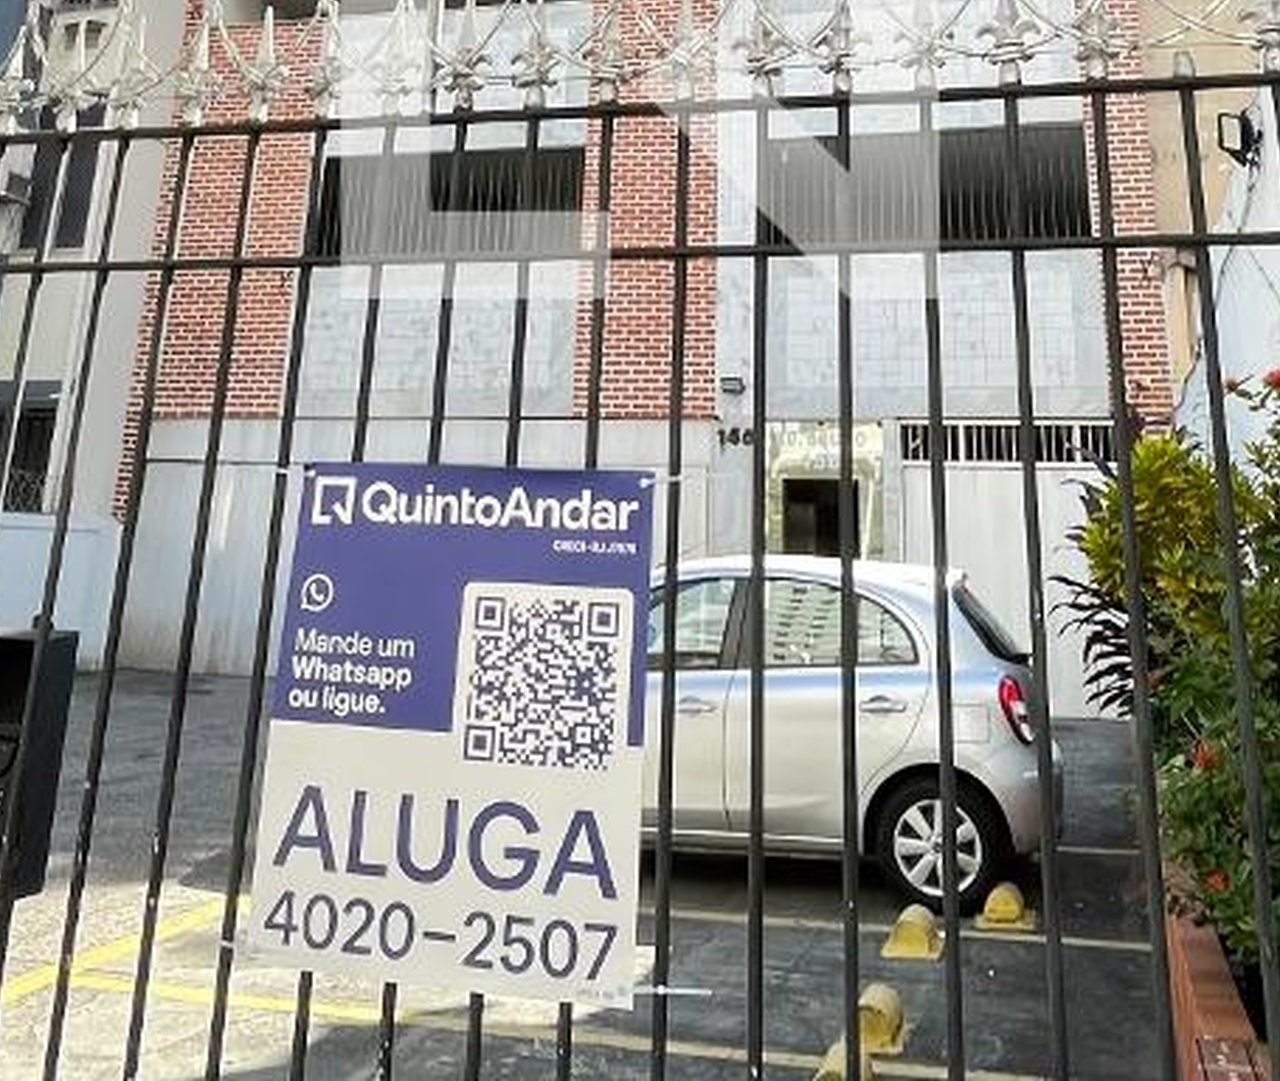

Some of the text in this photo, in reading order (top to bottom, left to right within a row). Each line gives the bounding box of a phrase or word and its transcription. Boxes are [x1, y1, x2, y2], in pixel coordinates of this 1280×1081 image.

[361, 480, 640, 532] QuintoAndar
[294, 627, 415, 658] Mande um
[290, 656, 413, 691] Whatsapp
[288, 688, 386, 717] ou ligue.
[272, 784, 618, 900] ALUGA
[263, 890, 618, 982] 4020-2507
